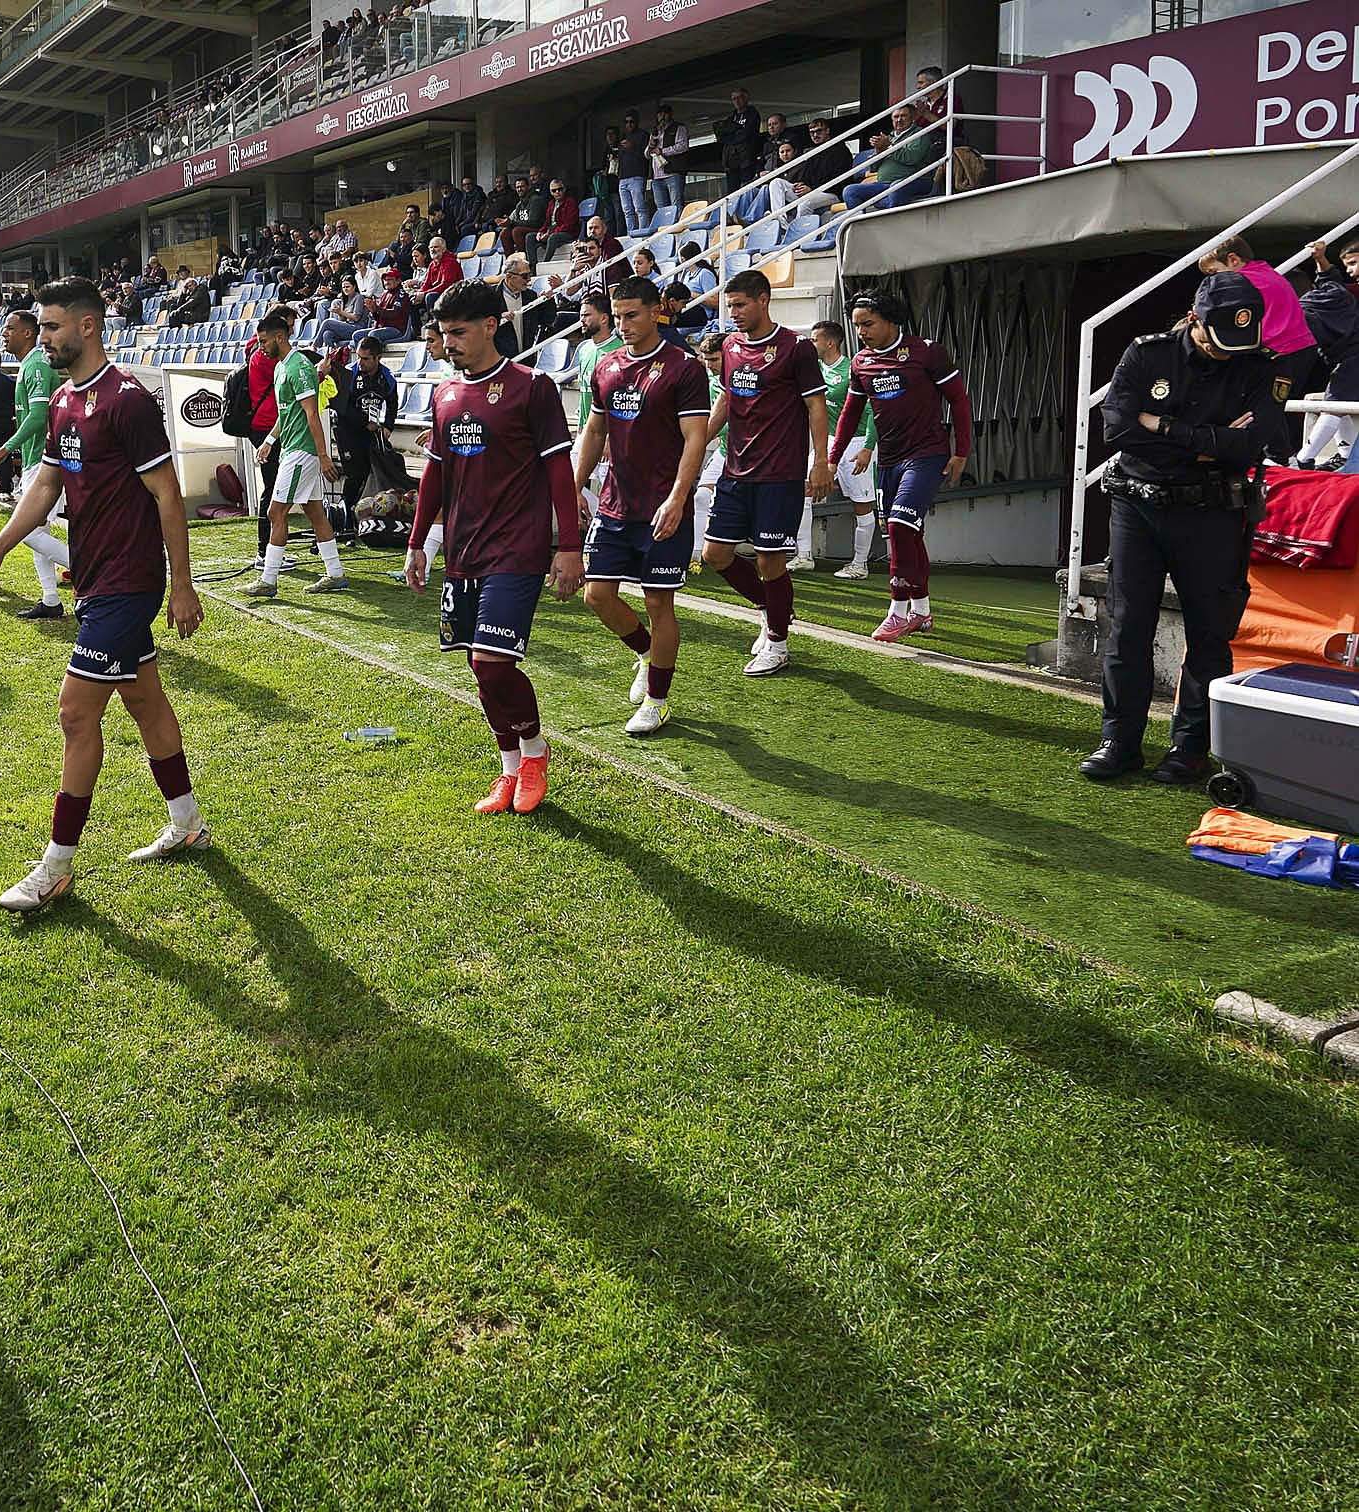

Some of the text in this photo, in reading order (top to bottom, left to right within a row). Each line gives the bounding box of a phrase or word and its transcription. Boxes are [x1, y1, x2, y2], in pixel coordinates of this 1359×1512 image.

[552, 7, 603, 37] CONSERVAS
[529, 16, 630, 72] PESCAMAR
[481, 56, 516, 78] PESCAMAR
[418, 79, 450, 98] PESCAMAR
[361, 85, 393, 105] CONSERVAS
[346, 93, 409, 132] PESCAMAR
[732, 370, 758, 381] Estrella
[872, 375, 900, 386] Estrella
[733, 379, 756, 389] Galicia
[874, 383, 900, 393] Galicia
[188, 401, 220, 411] Estrella
[190, 409, 219, 419] Galicia
[450, 423, 482, 434] Estrella
[451, 434, 482, 445] Galicia
[478, 623, 516, 639] ABANCA
